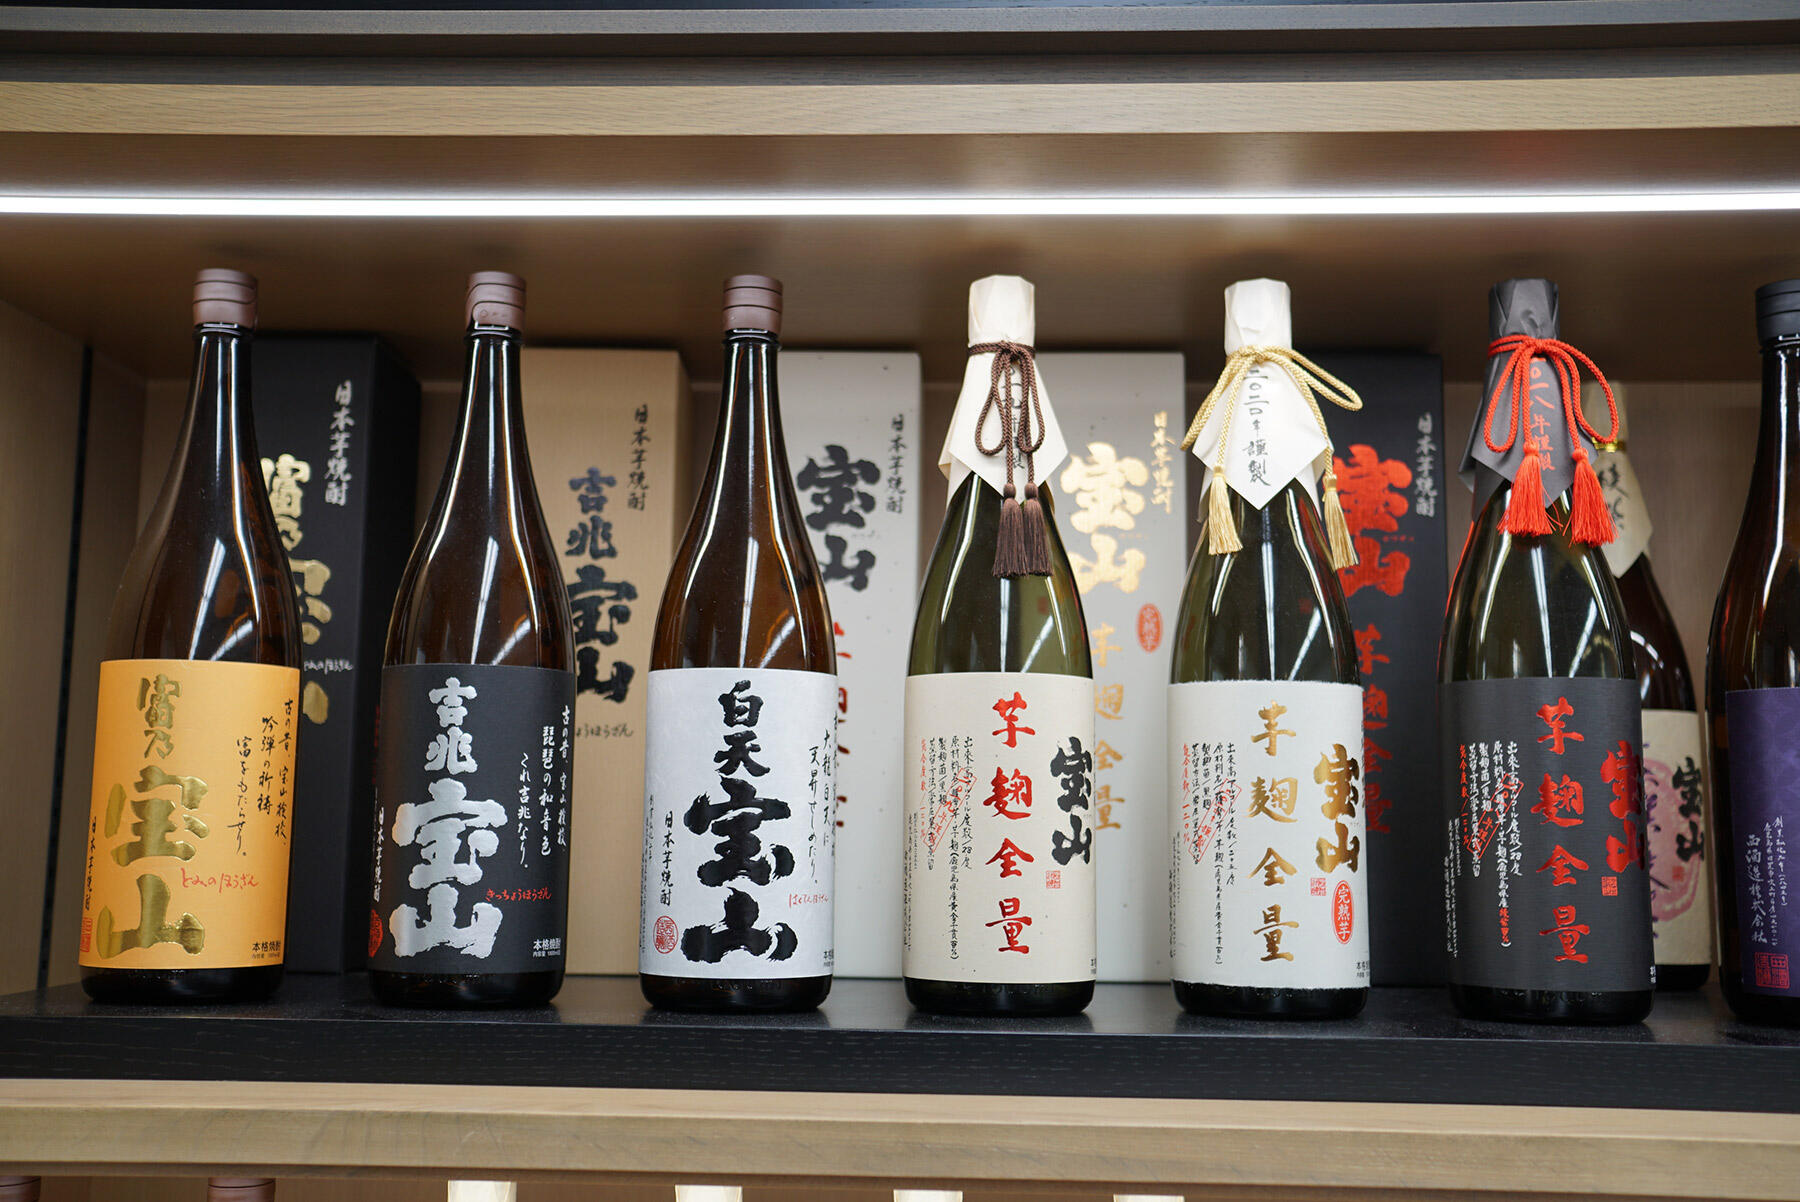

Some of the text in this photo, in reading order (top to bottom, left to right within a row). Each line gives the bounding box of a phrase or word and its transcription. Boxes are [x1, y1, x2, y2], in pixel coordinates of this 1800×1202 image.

[325, 380, 355, 506] 日本芋焼酎
[627, 404, 650, 511] 日本芋焼酎
[886, 413, 907, 514] 日本芋焼酎
[1415, 412, 1438, 518] 日本芋焼酎
[797, 444, 881, 592] 宝山
[1060, 442, 1149, 595] 宝山
[1333, 444, 1413, 598] 宝山
[565, 467, 638, 703] 吉兆宝山
[97, 673, 209, 959] 富乃宝山
[389, 677, 508, 959] 吉兆宝山
[517, 752, 532, 868] これ吉兆なり。
[538, 726, 555, 855] 琵琶の和音色
[680, 680, 799, 963] 白天宝山
[1051, 736, 1093, 866] 宝山
[1313, 743, 1360, 874] 宝山
[1600, 740, 1645, 874] 宝山
[1672, 756, 1705, 863] 宝山
[181, 867, 259, 893] とみのほうざん
[485, 887, 552, 902] きっちょうほうざん
[660, 811, 675, 906] 日本芋焼酎
[1337, 885, 1350, 940] 完熟芋
[1746, 834, 1768, 944] 西酒造株式会社
